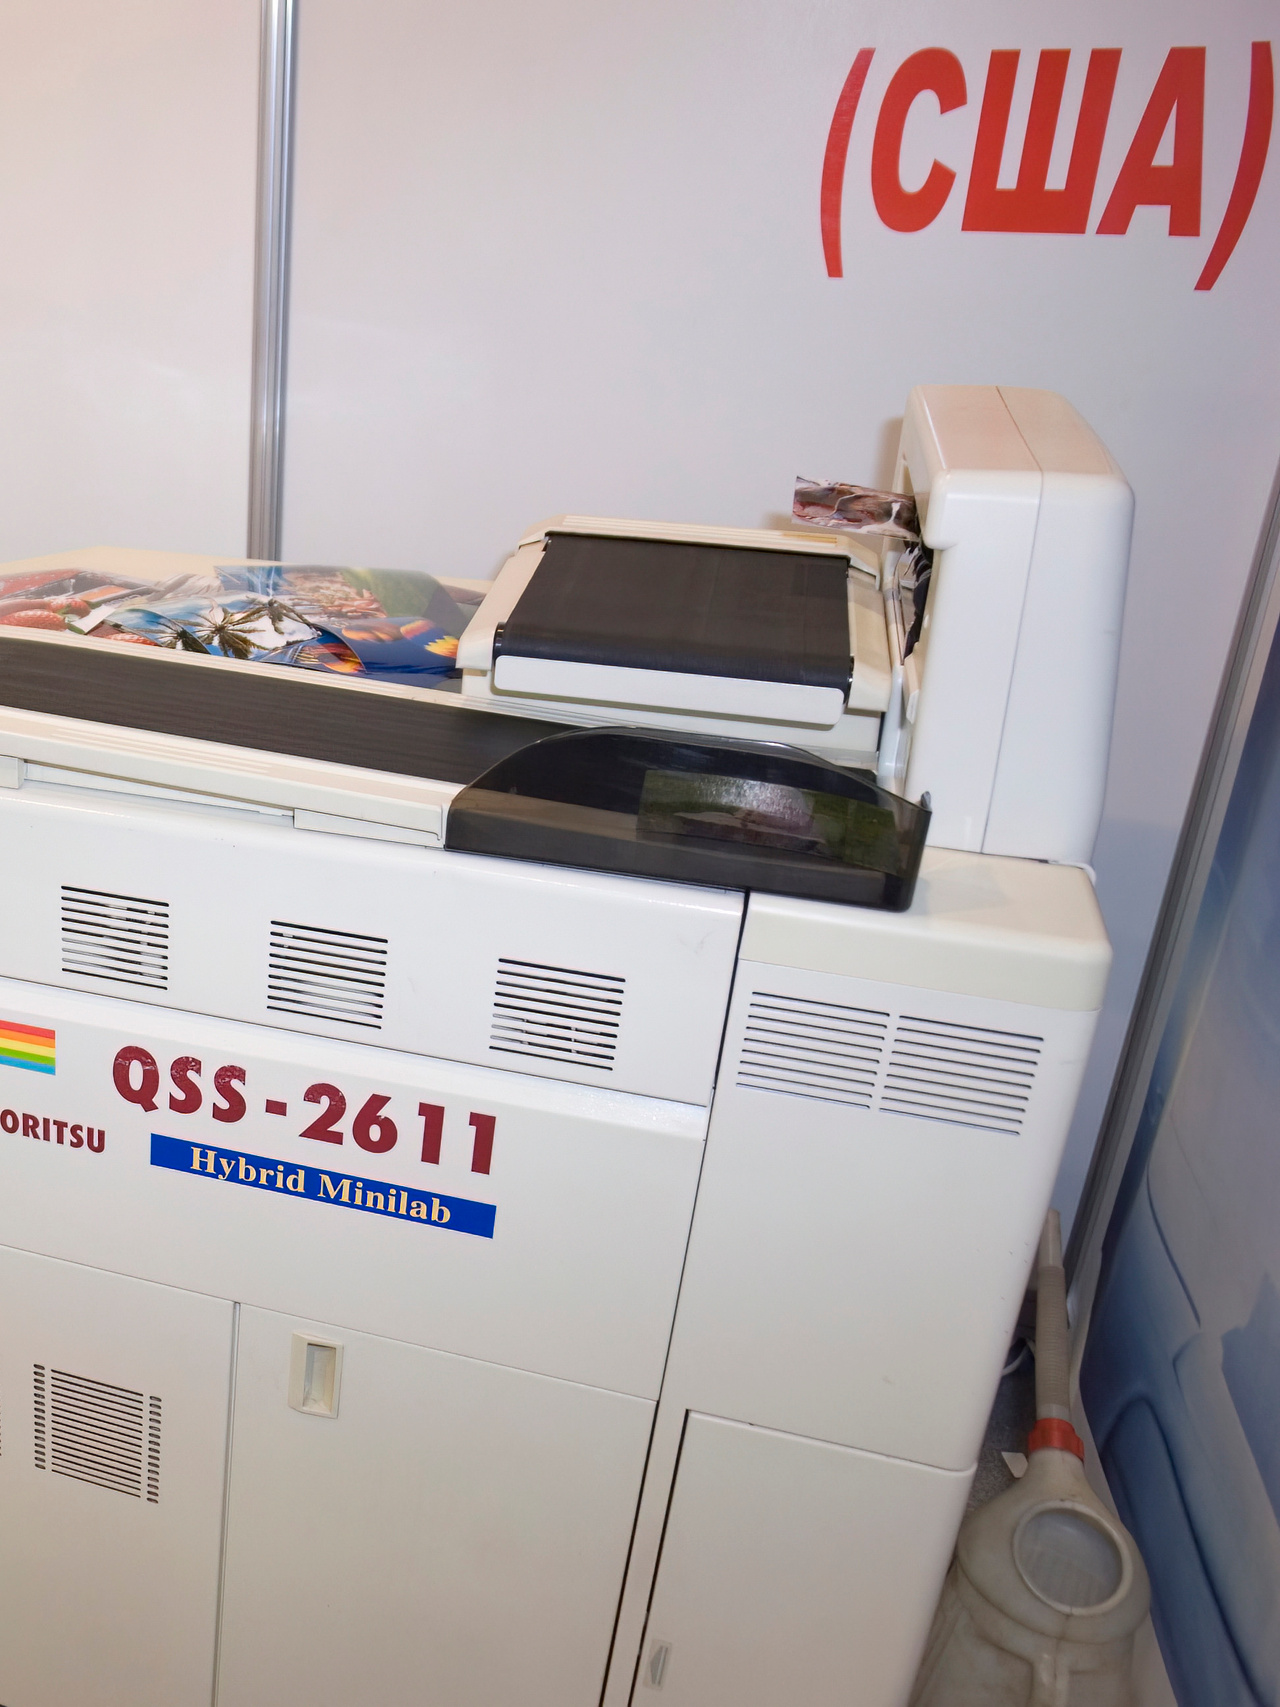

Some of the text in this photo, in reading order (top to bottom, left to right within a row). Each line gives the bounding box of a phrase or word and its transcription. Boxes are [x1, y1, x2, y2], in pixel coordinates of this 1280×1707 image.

[819, 40, 1275, 291] (США)
[112, 1045, 497, 1175] QSS-2611
[190, 1146, 451, 1224] Hybrid Minilab
